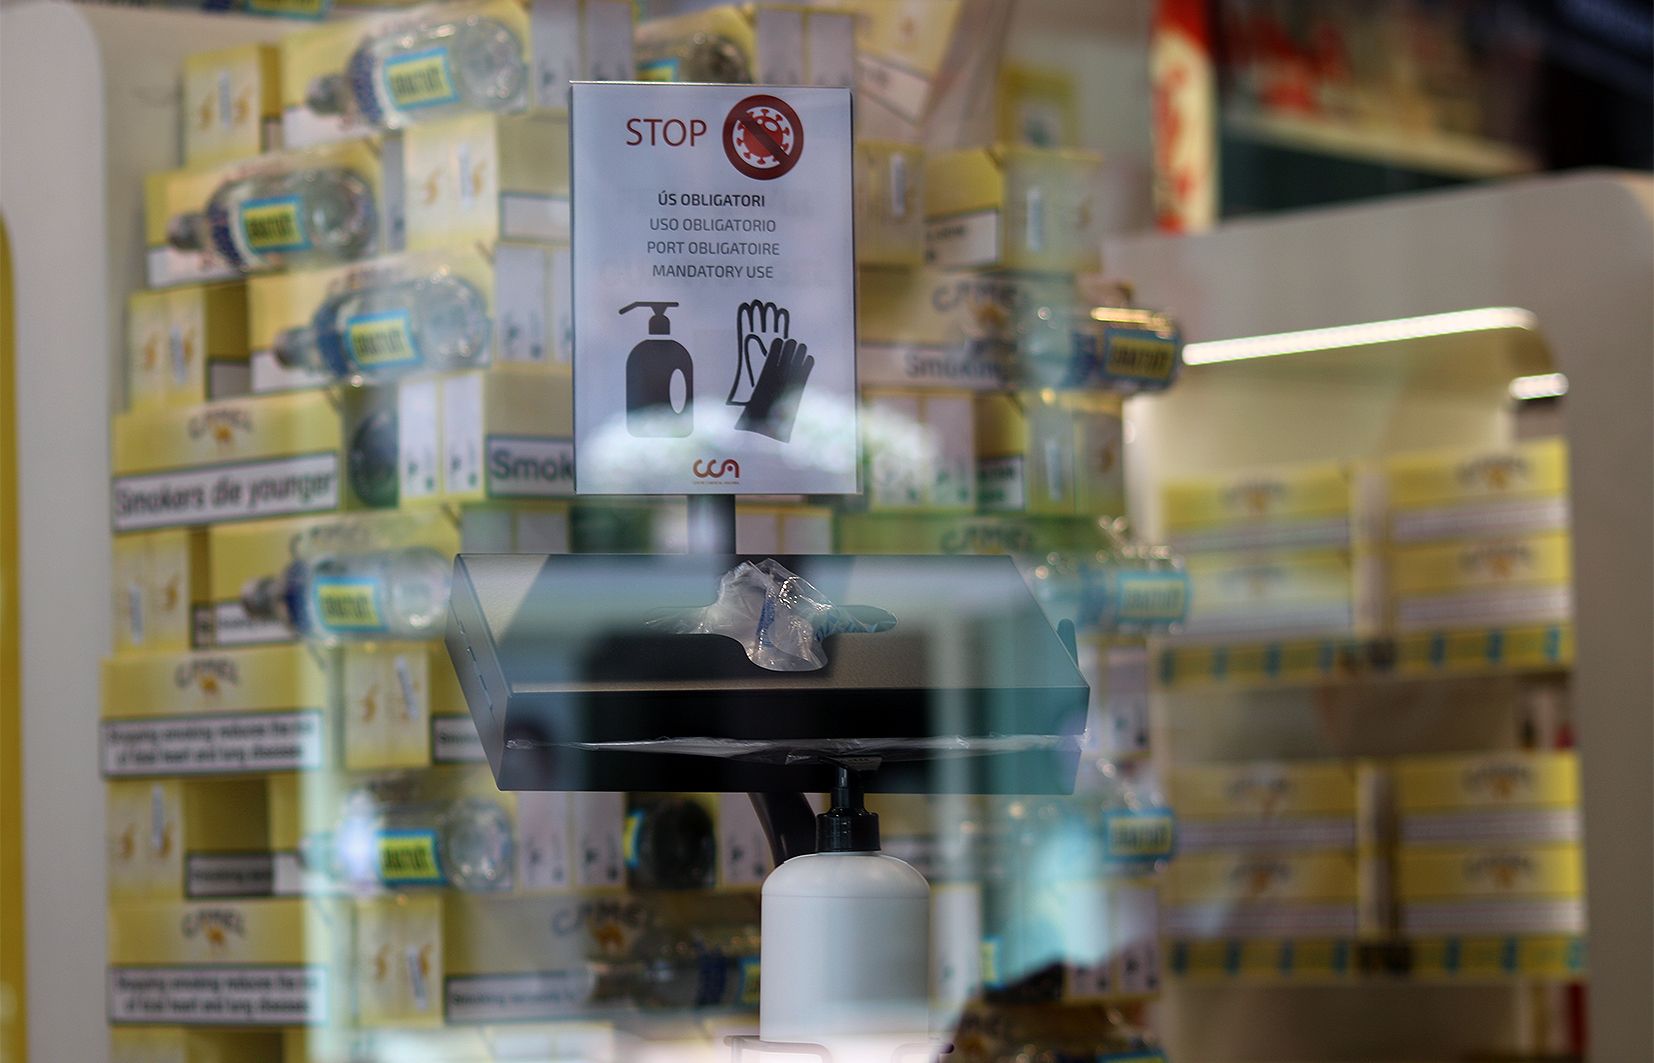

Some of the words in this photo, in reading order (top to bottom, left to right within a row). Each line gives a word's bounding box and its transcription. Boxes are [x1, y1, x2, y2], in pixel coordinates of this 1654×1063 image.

[625, 117, 707, 147] STOP
[657, 190, 677, 207] ÚS
[681, 194, 766, 208] OBLIGATORI
[649, 218, 679, 231] USO
[682, 218, 777, 233] OBLIGATORIO
[647, 241, 683, 255] PORT
[688, 242, 780, 256] OBLIGATOIRE
[652, 264, 743, 279] MANDATORY
[746, 265, 773, 279] USE
